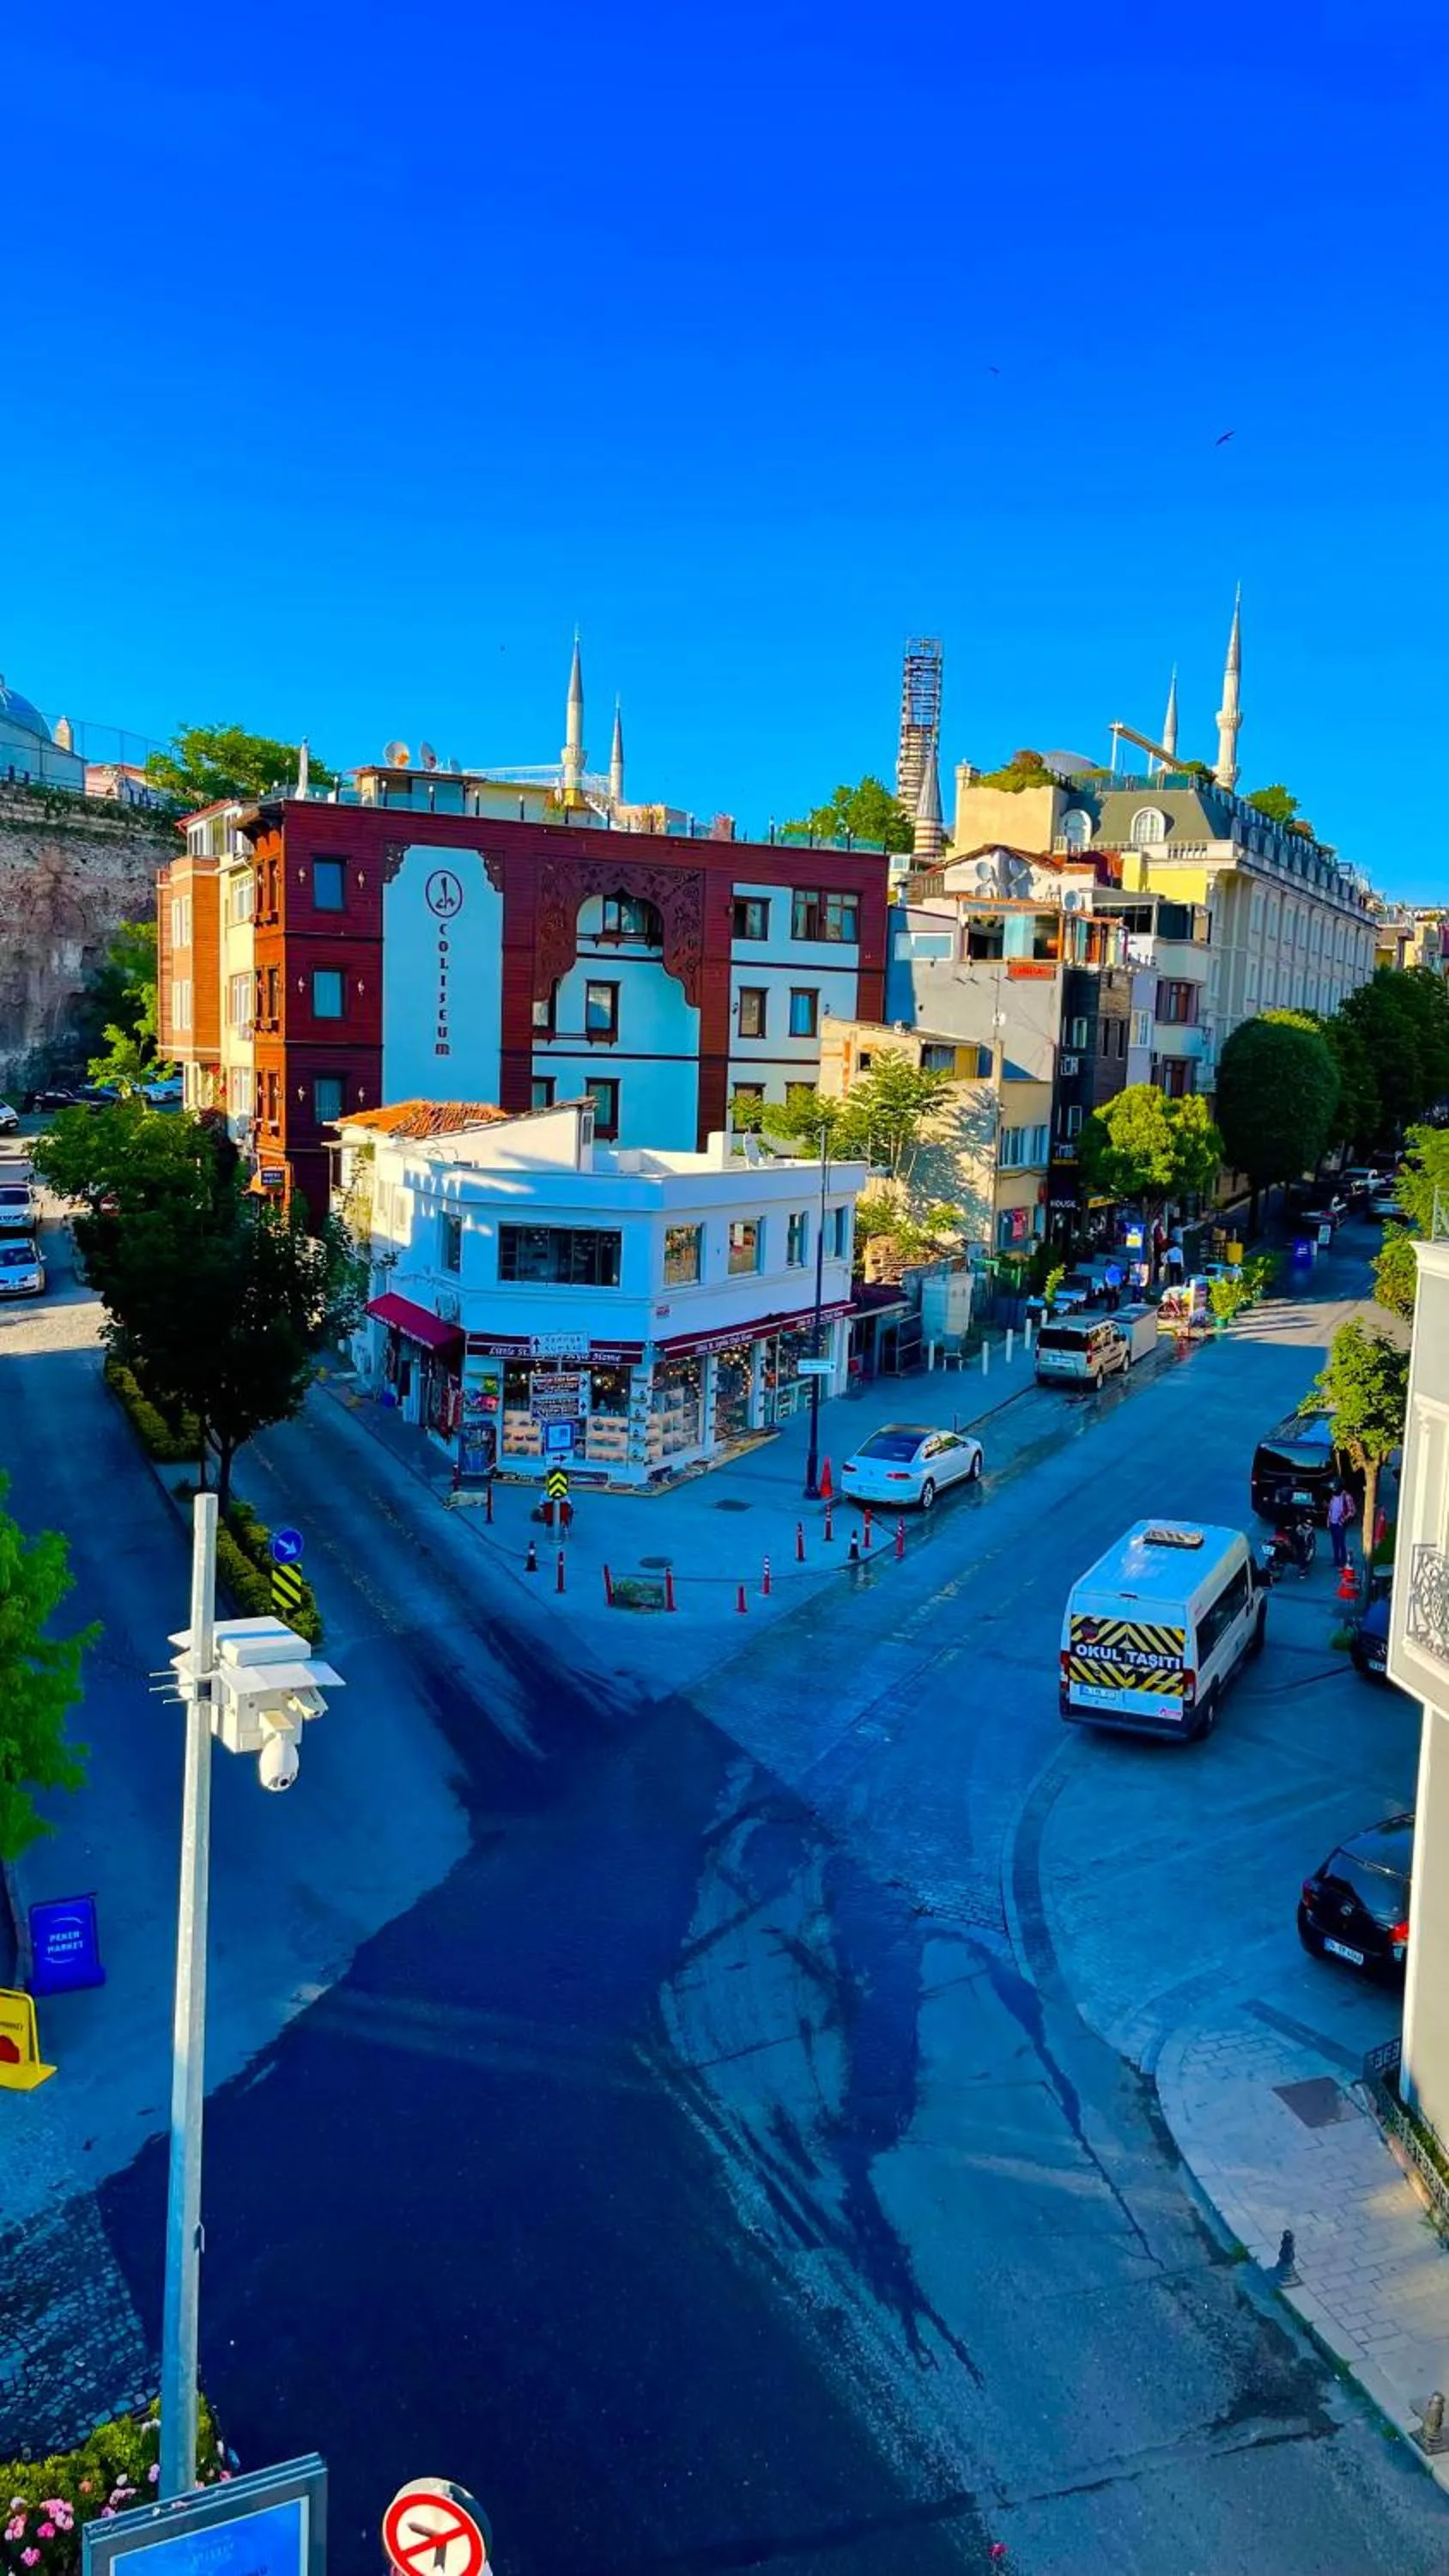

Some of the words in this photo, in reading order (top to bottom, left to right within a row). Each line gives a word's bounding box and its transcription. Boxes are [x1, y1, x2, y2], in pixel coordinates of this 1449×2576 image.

[435, 922, 451, 1056] COLISEUM
[1075, 1643, 1122, 1662] OKUL
[1125, 1650, 1181, 1670] TAŞITI
[47, 1941, 83, 1955] MARKET
